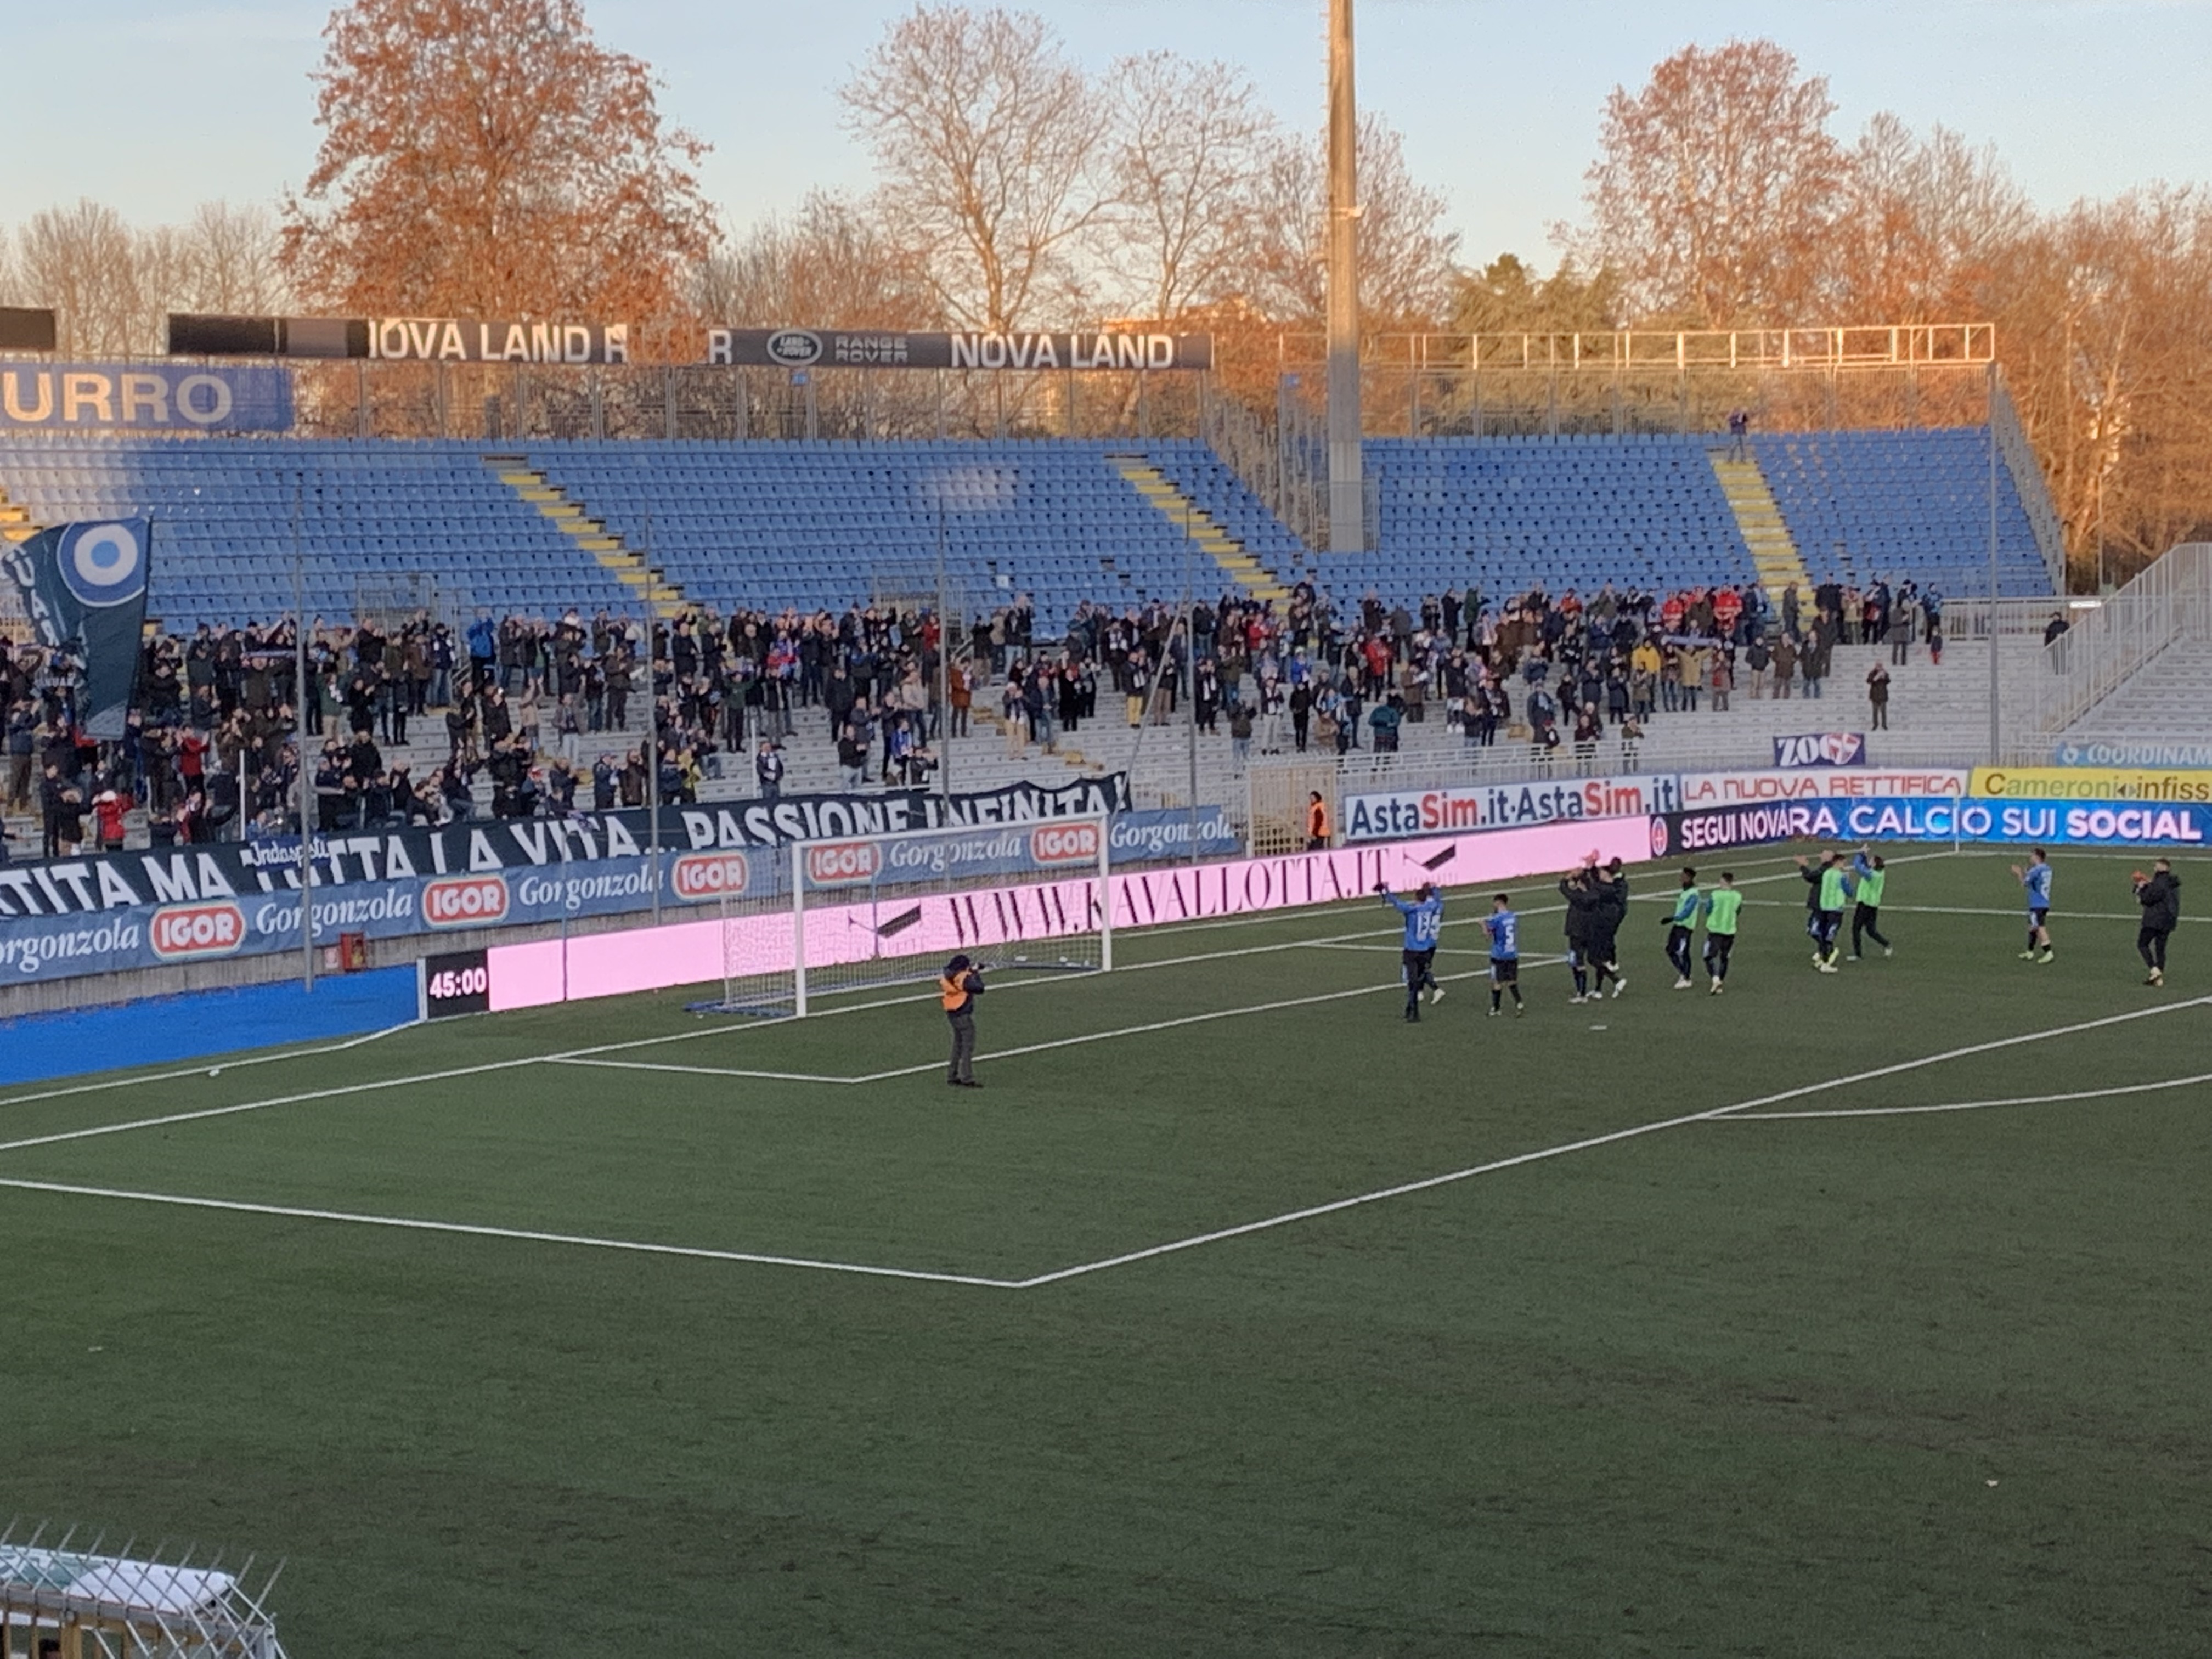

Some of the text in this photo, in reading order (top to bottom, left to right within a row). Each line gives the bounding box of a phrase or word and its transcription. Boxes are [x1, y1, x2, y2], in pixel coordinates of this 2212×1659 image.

[480, 322, 591, 363] LAND
[708, 330, 732, 364] R
[835, 335, 907, 349] RANGE
[835, 349, 908, 363] ROVER
[951, 332, 1174, 368] NOVA LAND
[3, 371, 233, 424] URRO
[1684, 781, 1717, 801] LA
[1829, 775, 1961, 798] RETTIFICA
[1985, 774, 2210, 801] Cameroni infiss
[1681, 806, 2202, 849] SEGUI NOVARA CALCIO SUI SOCIAL
[0, 860, 142, 915] TITA
[140, 852, 236, 902] MA
[428, 828, 504, 875] LA
[681, 798, 911, 850] PASSIONE
[161, 912, 235, 948] IGOR
[256, 887, 413, 937] Gorgonzola
[432, 885, 500, 918] IGOR
[681, 860, 743, 891] IGOR
[814, 848, 872, 877] IGOR
[1037, 829, 1096, 857] IGOR
[1109, 814, 1234, 851] Gorgonola
[949, 847, 1390, 948] WWW.KAVALLOTTA.IT
[430, 967, 487, 999] 45:00
